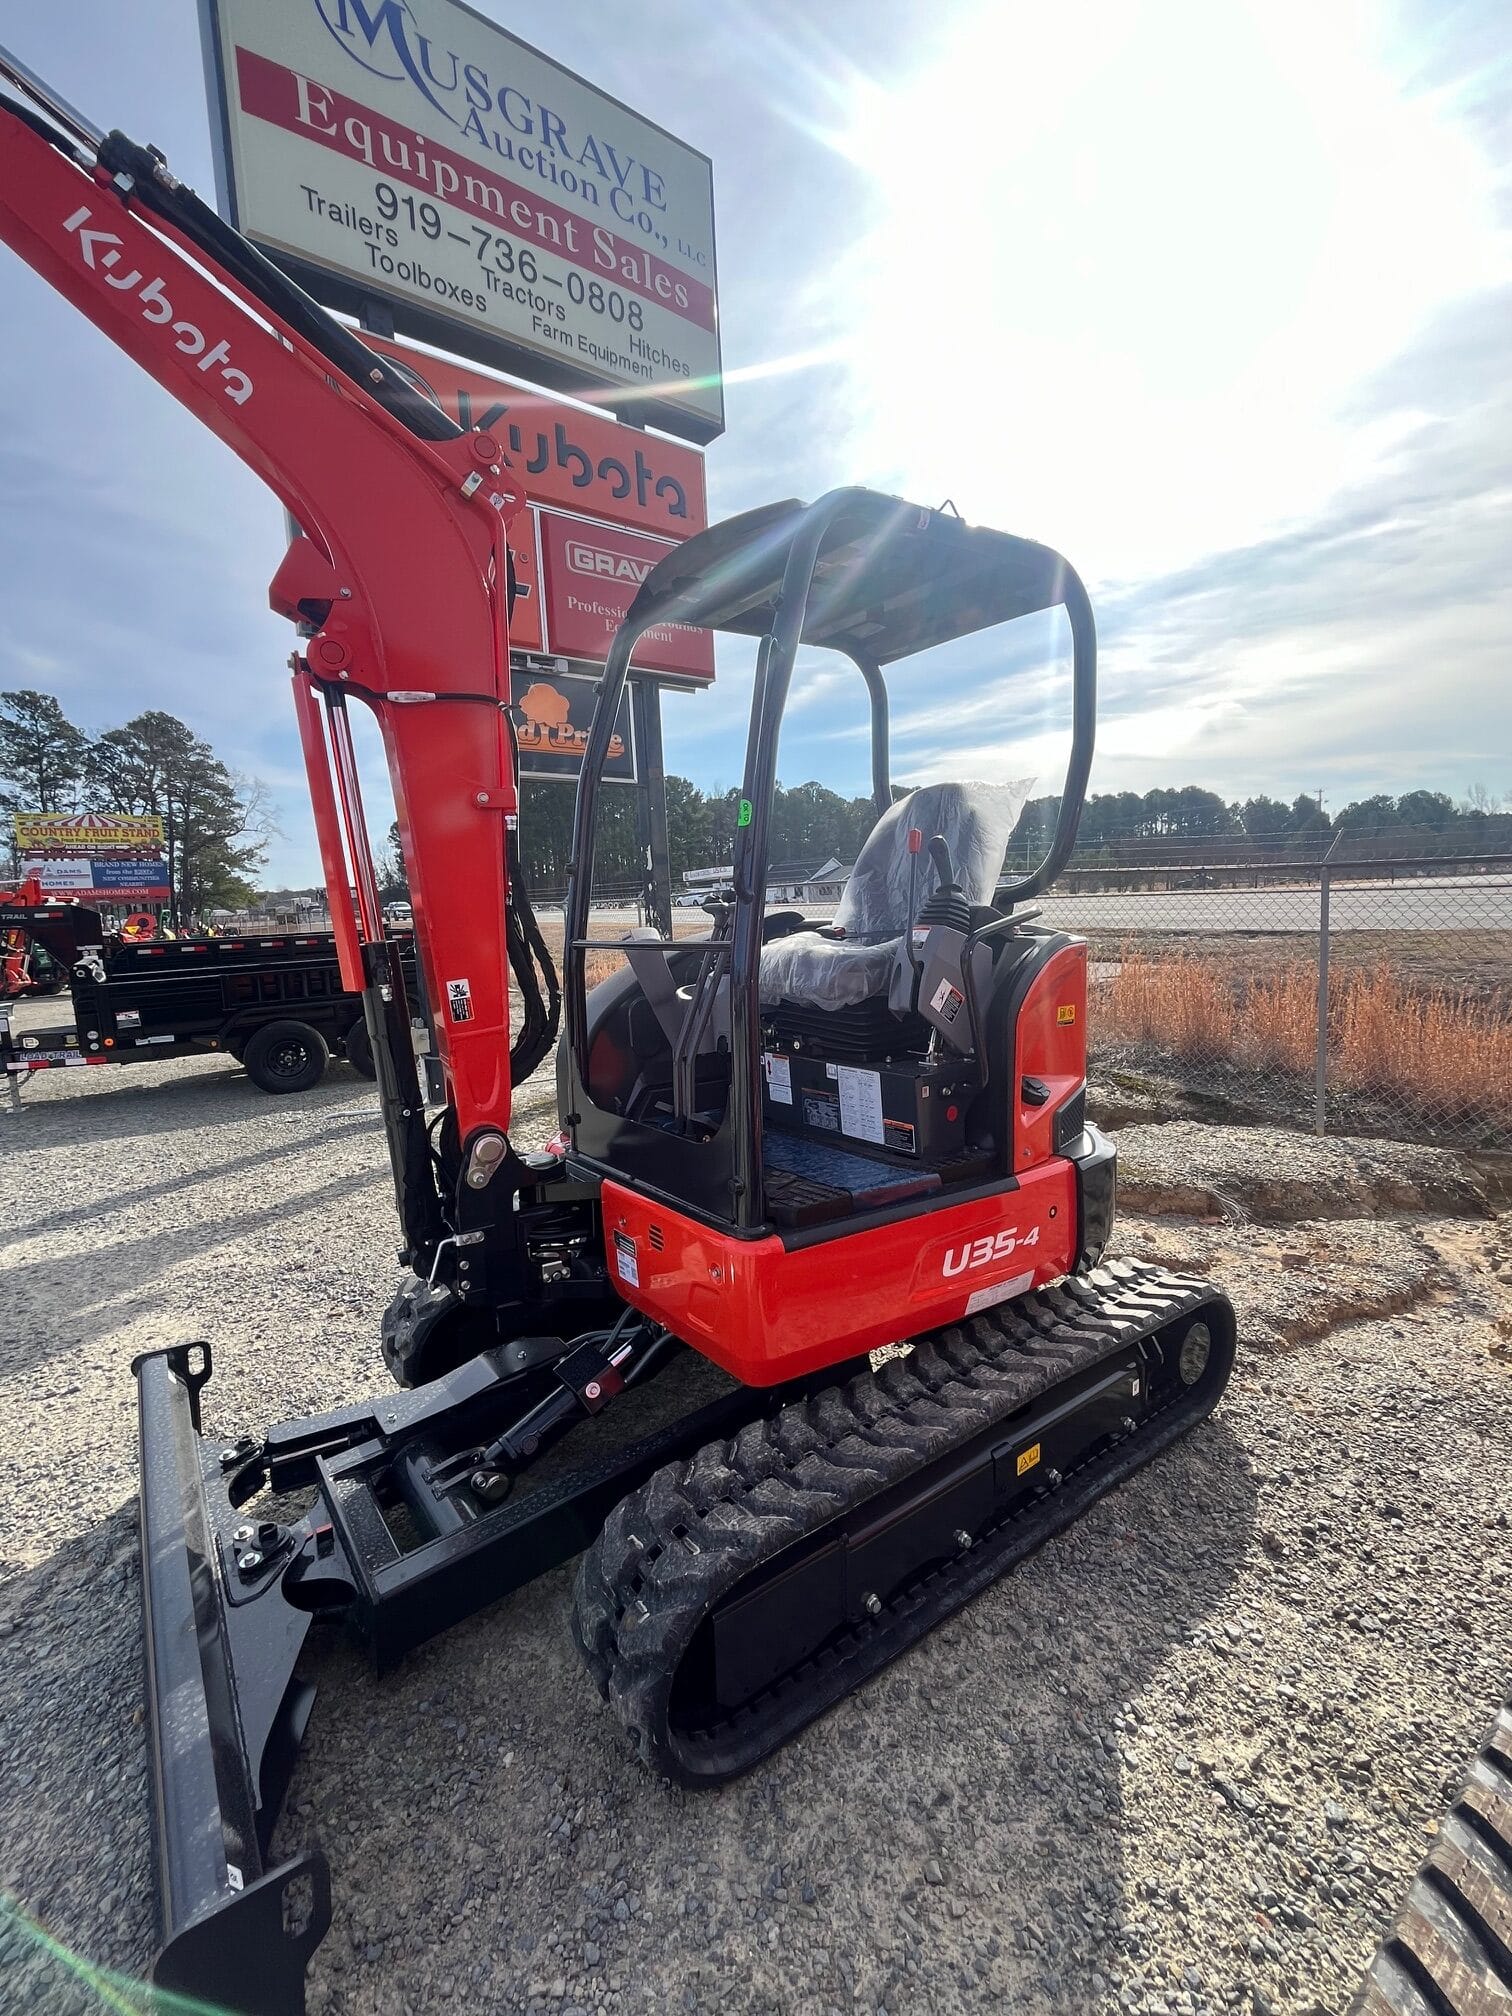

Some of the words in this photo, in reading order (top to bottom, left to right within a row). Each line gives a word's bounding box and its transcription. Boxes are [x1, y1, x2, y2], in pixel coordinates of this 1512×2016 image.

[290, 71, 580, 253] Equipment
[592, 226, 690, 309] Sales
[460, 106, 600, 206] Auction
[609, 186, 669, 249] Co.,
[677, 238, 706, 267] LLC
[62, 206, 254, 405] Kubota
[300, 184, 399, 246] Trailers
[480, 265, 567, 321] Tractors
[628, 333, 691, 377] Hitches
[363, 241, 488, 313] Toolboxes
[531, 315, 573, 349] Farm
[577, 333, 654, 380] Equipment
[374, 182, 644, 331] 919-736-0808
[457, 388, 688, 520] Kubota
[567, 595, 628, 619] Professio
[573, 547, 656, 583] GRAV
[20, 827, 81, 837] COUNTRY
[85, 827, 119, 837] FRUIT
[122, 828, 160, 838] STAND
[20, 1051, 47, 1061] LOAD
[53, 1050, 82, 1060] TRAIL
[942, 1225, 1040, 1278] U35-4
